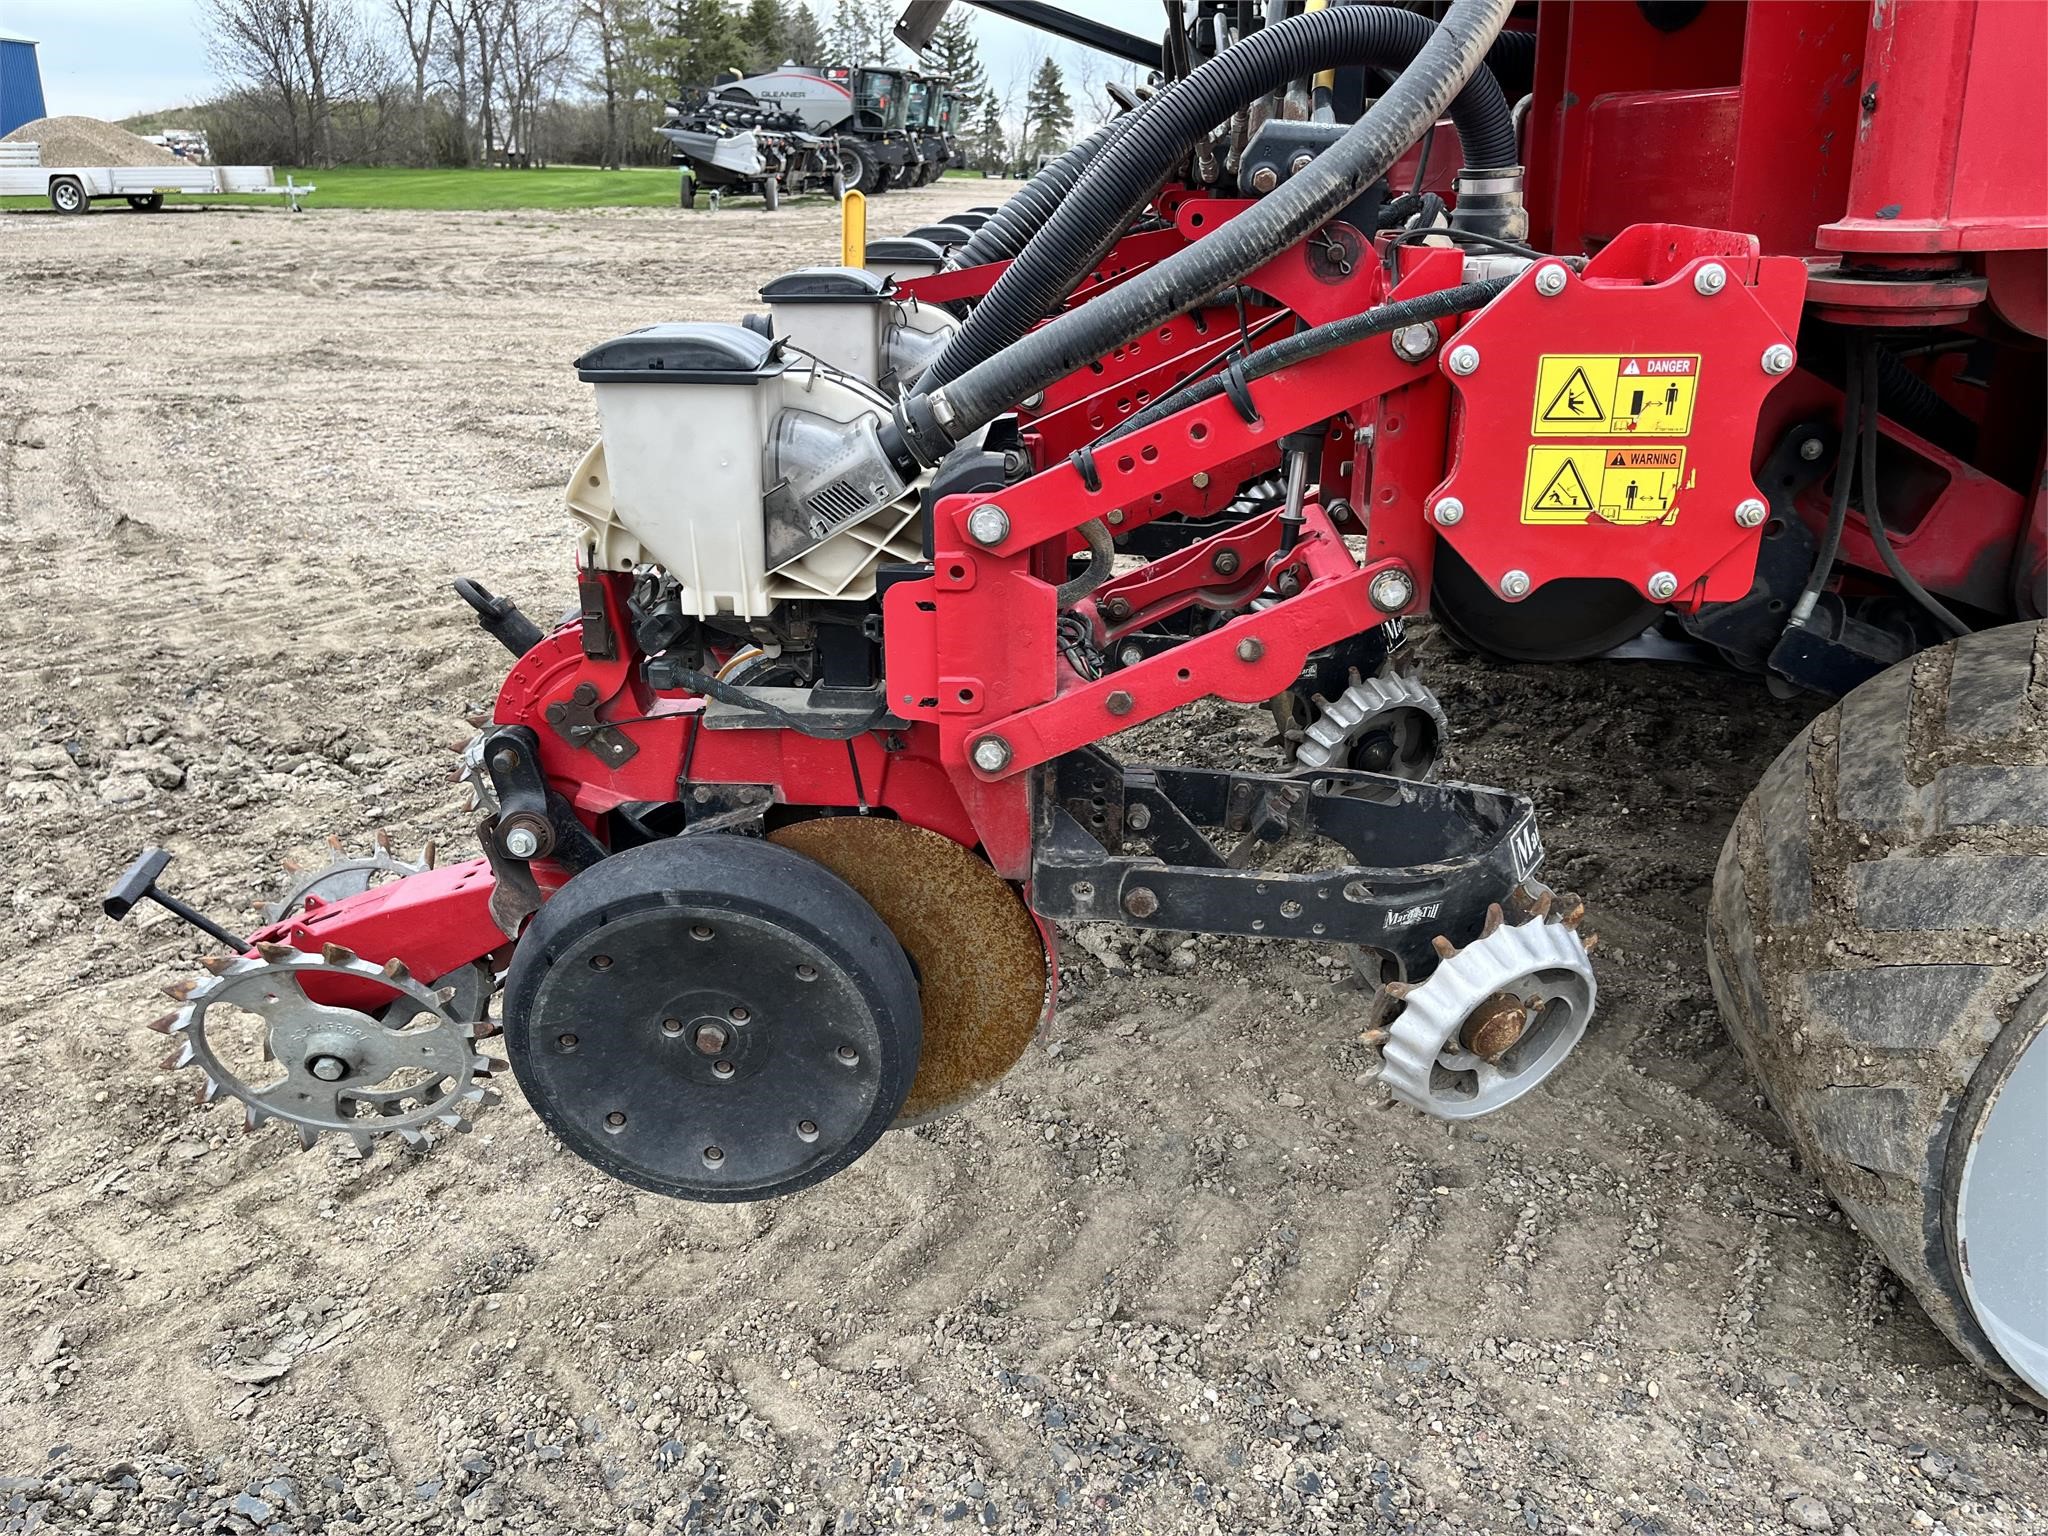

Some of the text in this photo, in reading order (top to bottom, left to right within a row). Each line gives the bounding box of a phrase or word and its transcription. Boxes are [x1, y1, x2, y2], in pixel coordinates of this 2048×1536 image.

[761, 90, 806, 98] GLEANER
[1647, 360, 1690, 373] DANGER
[1630, 453, 1677, 465] WARNING
